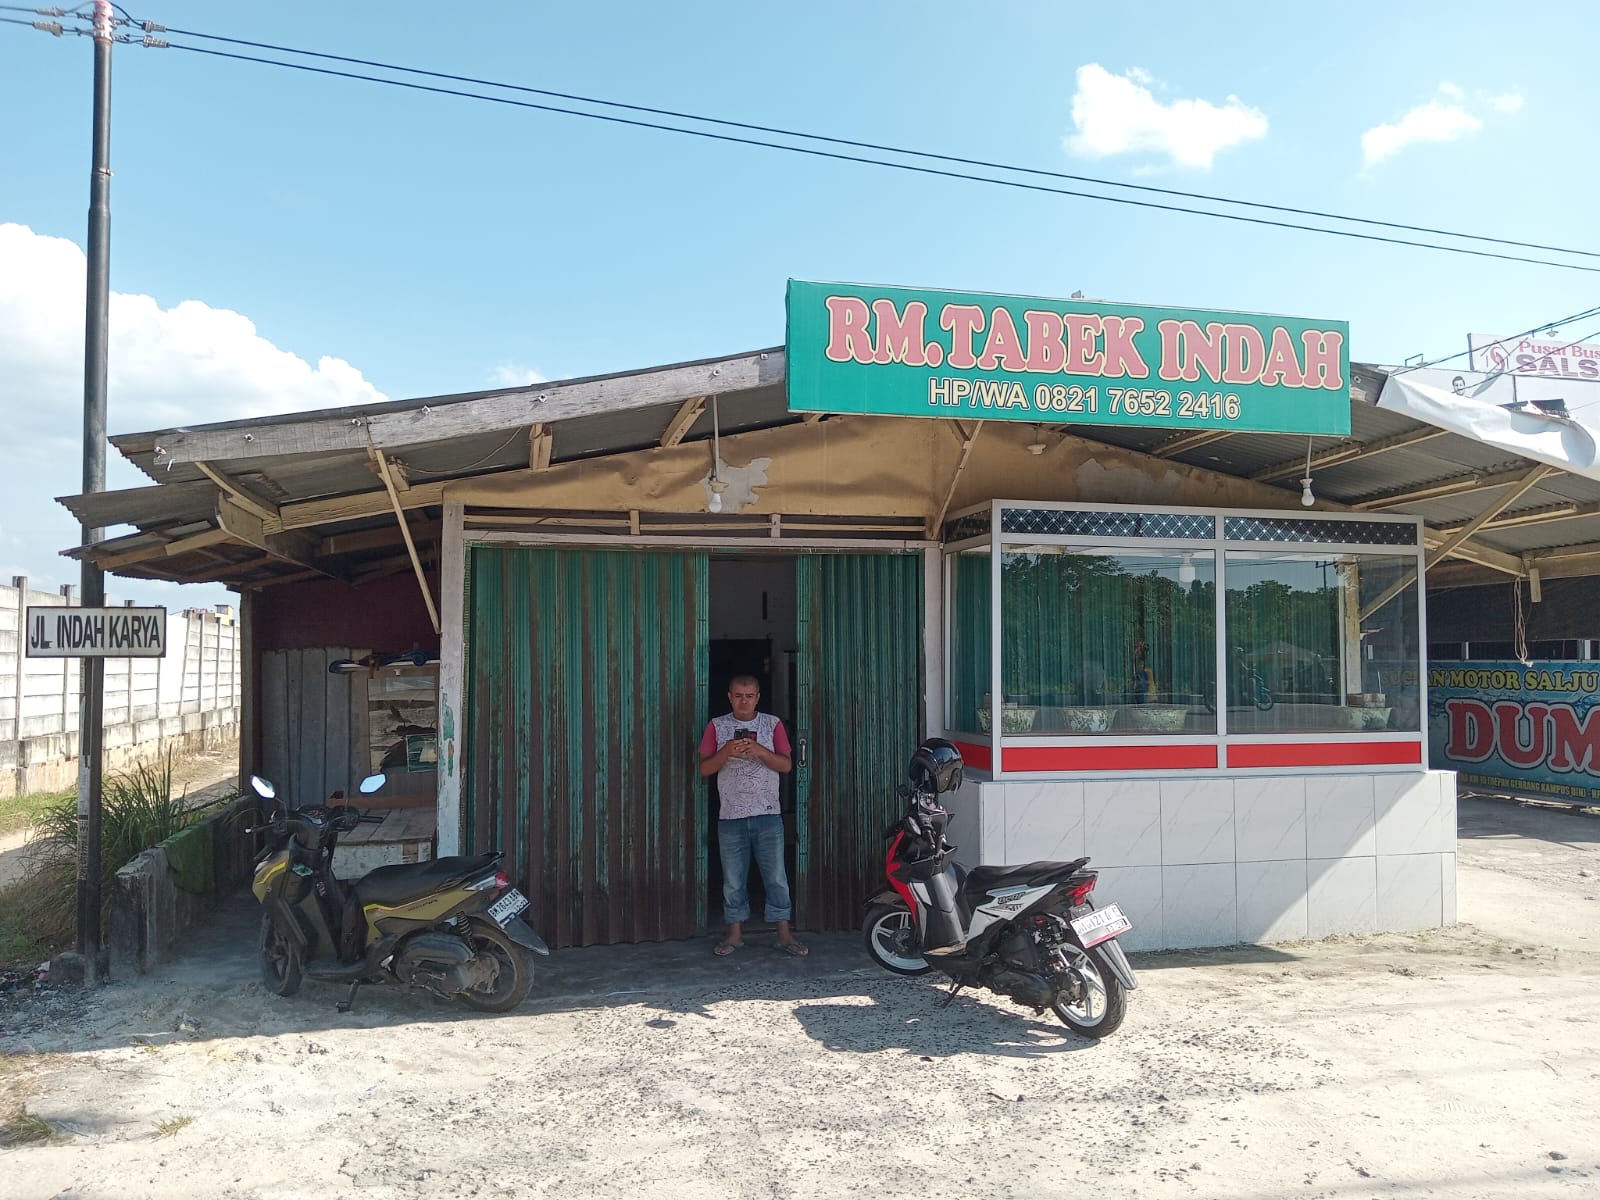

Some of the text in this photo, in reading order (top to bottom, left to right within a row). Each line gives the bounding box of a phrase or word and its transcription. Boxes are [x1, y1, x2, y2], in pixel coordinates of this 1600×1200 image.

[1158, 319, 1344, 390] INDAH
[928, 377, 1241, 420] HP/WA 0821 7652 2416
[57, 615, 104, 651] INDAH
[109, 615, 161, 649] KARYA
[1450, 669, 1520, 690] MOTOR
[1524, 670, 1600, 692] SALJU
